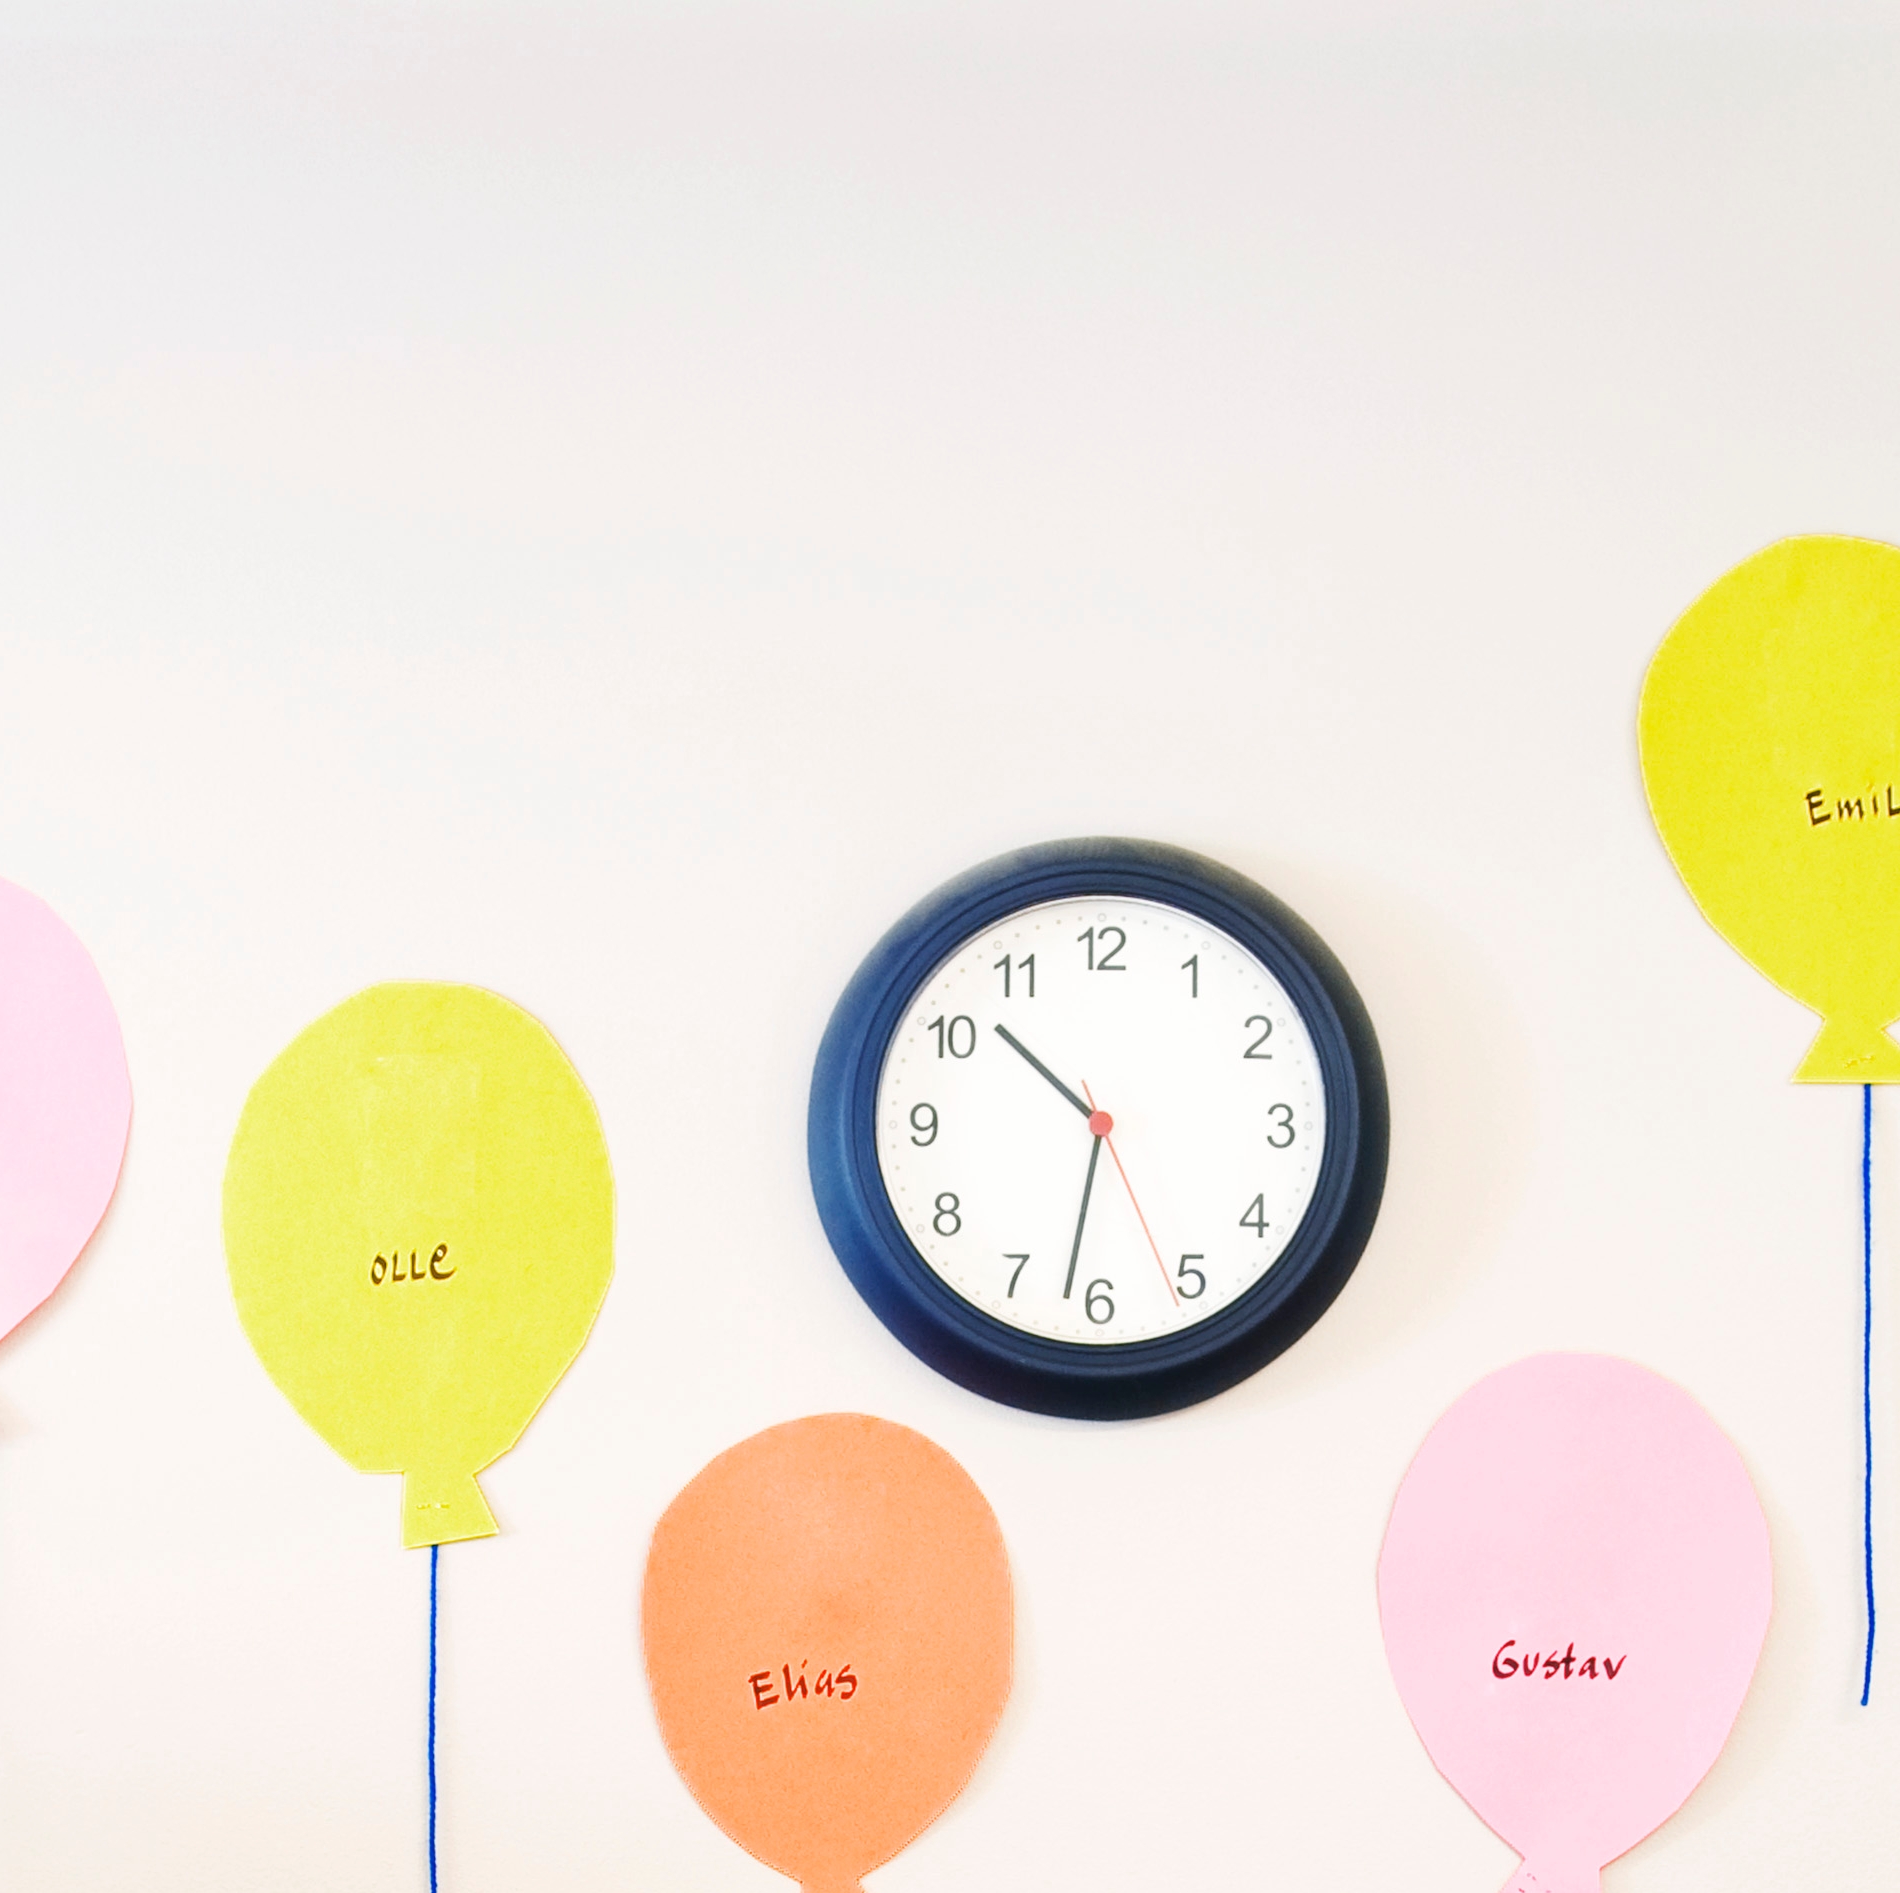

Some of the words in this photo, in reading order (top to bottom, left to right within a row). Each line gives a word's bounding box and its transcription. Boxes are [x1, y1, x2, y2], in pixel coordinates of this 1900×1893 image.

[1076, 926, 1127, 971] 12
[993, 953, 1036, 998] 11
[1181, 954, 1199, 998] 1
[926, 1014, 977, 1059] 10
[1242, 1015, 1273, 1060] 2
[908, 1102, 939, 1147] 9
[1265, 1103, 1296, 1148] 3
[931, 1192, 962, 1237] 8
[1238, 1193, 1270, 1238] 4
[1001, 1253, 1030, 1298] 7
[1176, 1254, 1207, 1299] 5
[1084, 1278, 1115, 1324] 6
[1491, 1639, 1627, 1681] Gustav
[747, 1658, 858, 1711] Elias
